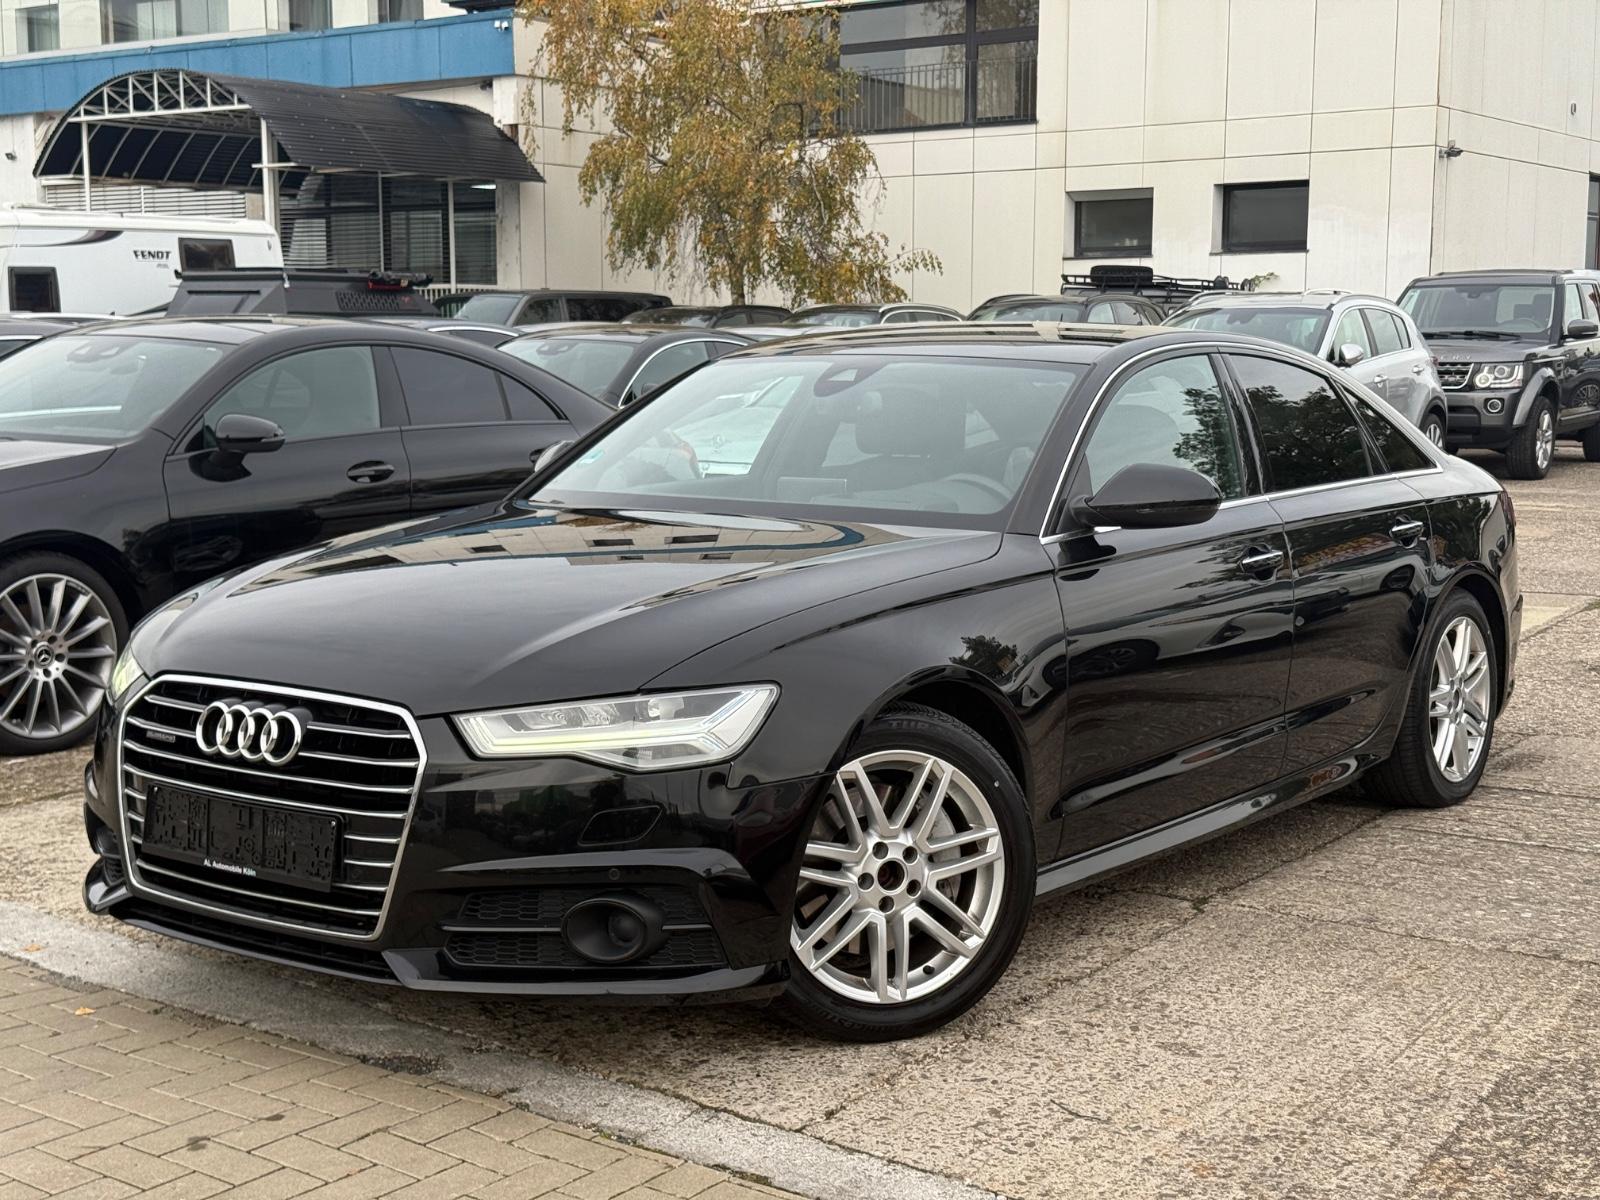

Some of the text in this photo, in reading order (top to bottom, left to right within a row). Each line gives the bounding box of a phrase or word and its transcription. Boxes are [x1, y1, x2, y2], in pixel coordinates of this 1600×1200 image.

[133, 250, 171, 260] FENDT
[212, 860, 242, 873] Automobile
[243, 867, 256, 876] Köln
